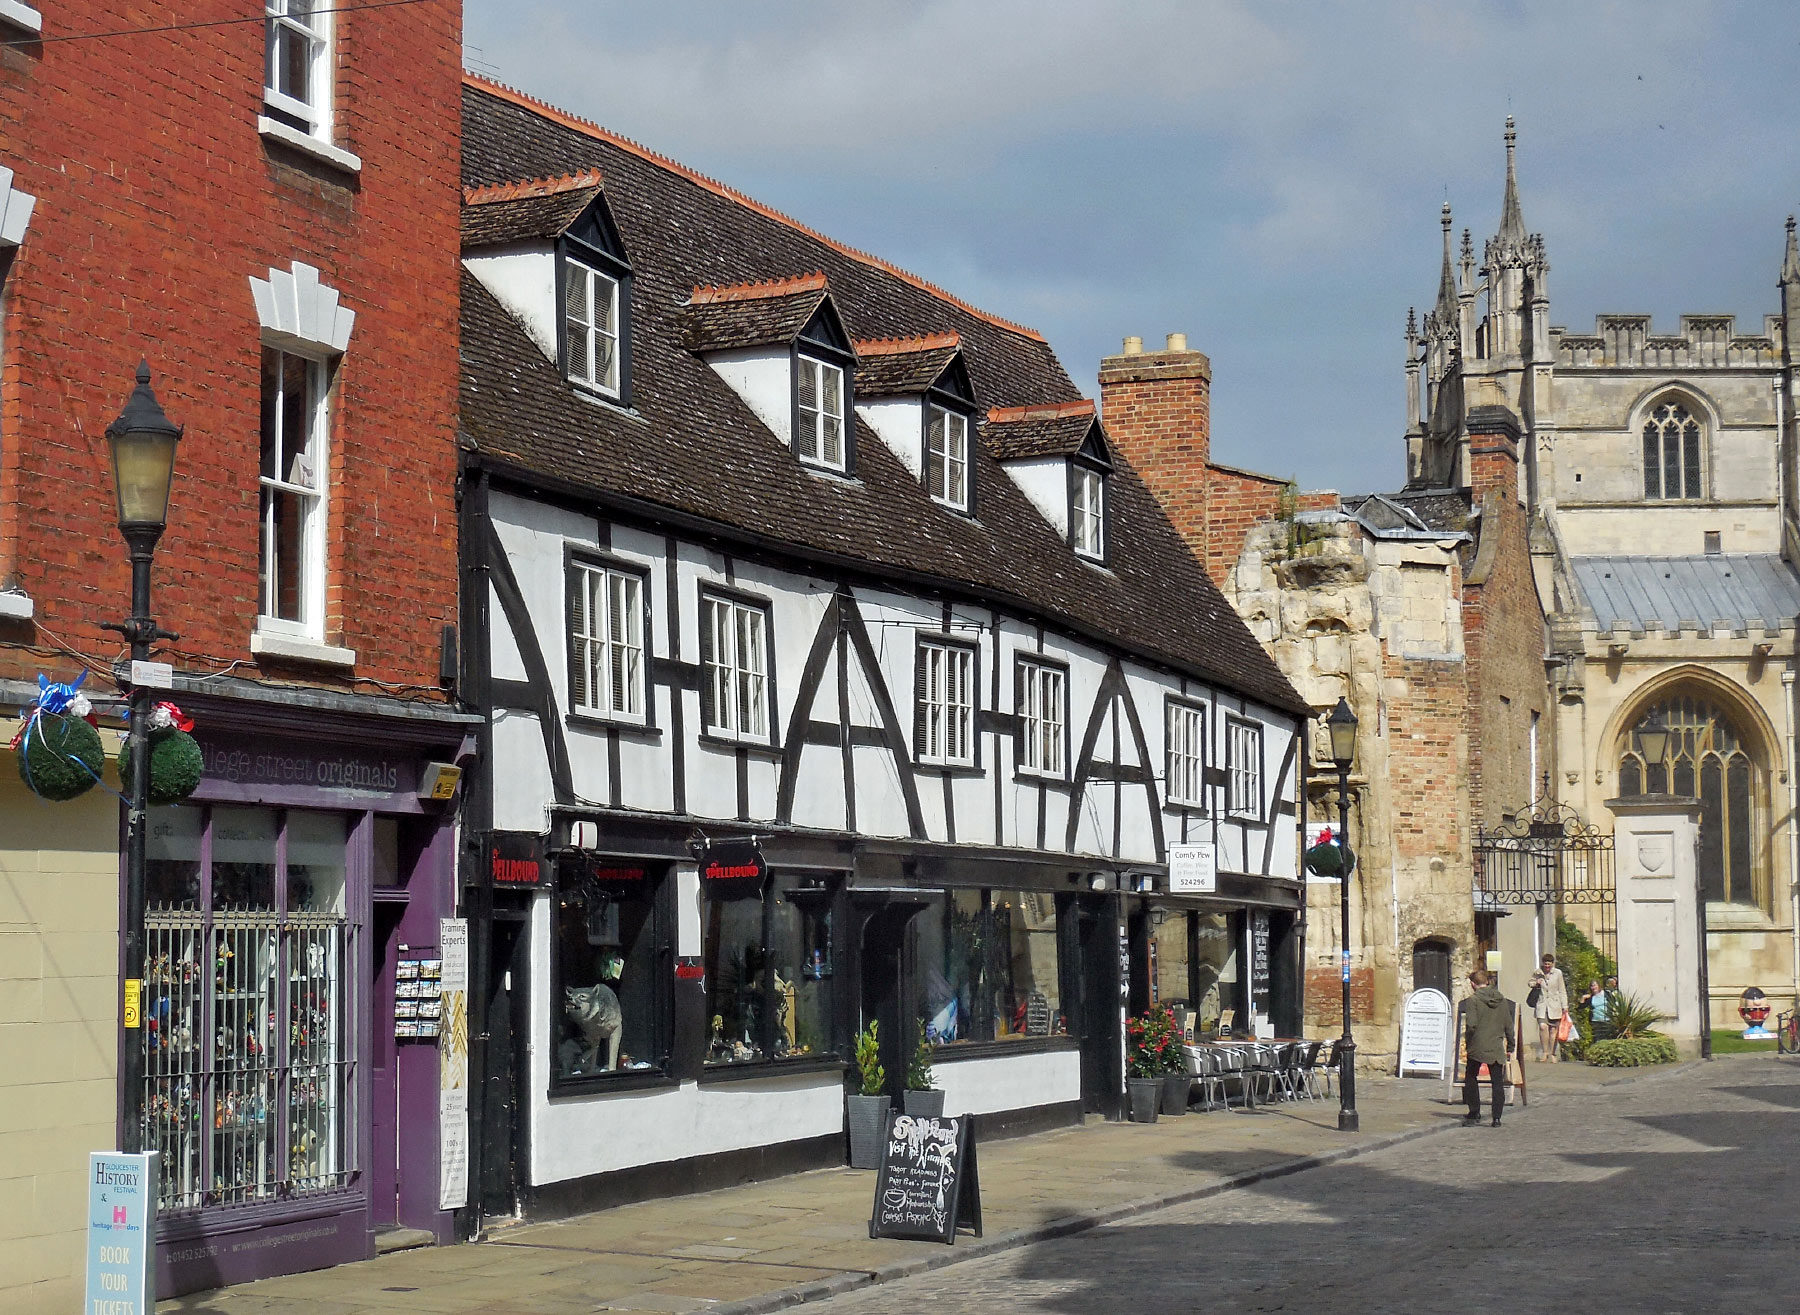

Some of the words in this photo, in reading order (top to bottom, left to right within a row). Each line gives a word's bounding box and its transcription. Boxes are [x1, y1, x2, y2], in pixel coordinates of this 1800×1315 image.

[255, 755, 313, 782] street
[317, 758, 398, 790] originals
[1174, 851, 1195, 860] Comfy
[1197, 851, 1211, 859] Pew
[493, 859, 540, 883] PELLBOUND
[705, 865, 760, 879] SPELLBOUND
[441, 922, 466, 935] Framing
[441, 935, 466, 948] Experts
[96, 1163, 139, 1186] HISTORY
[126, 1224, 140, 1232] days
[101, 1246, 130, 1265] BOOK
[101, 1272, 128, 1292] YOUR
[94, 1299, 135, 1315] TICKETS
